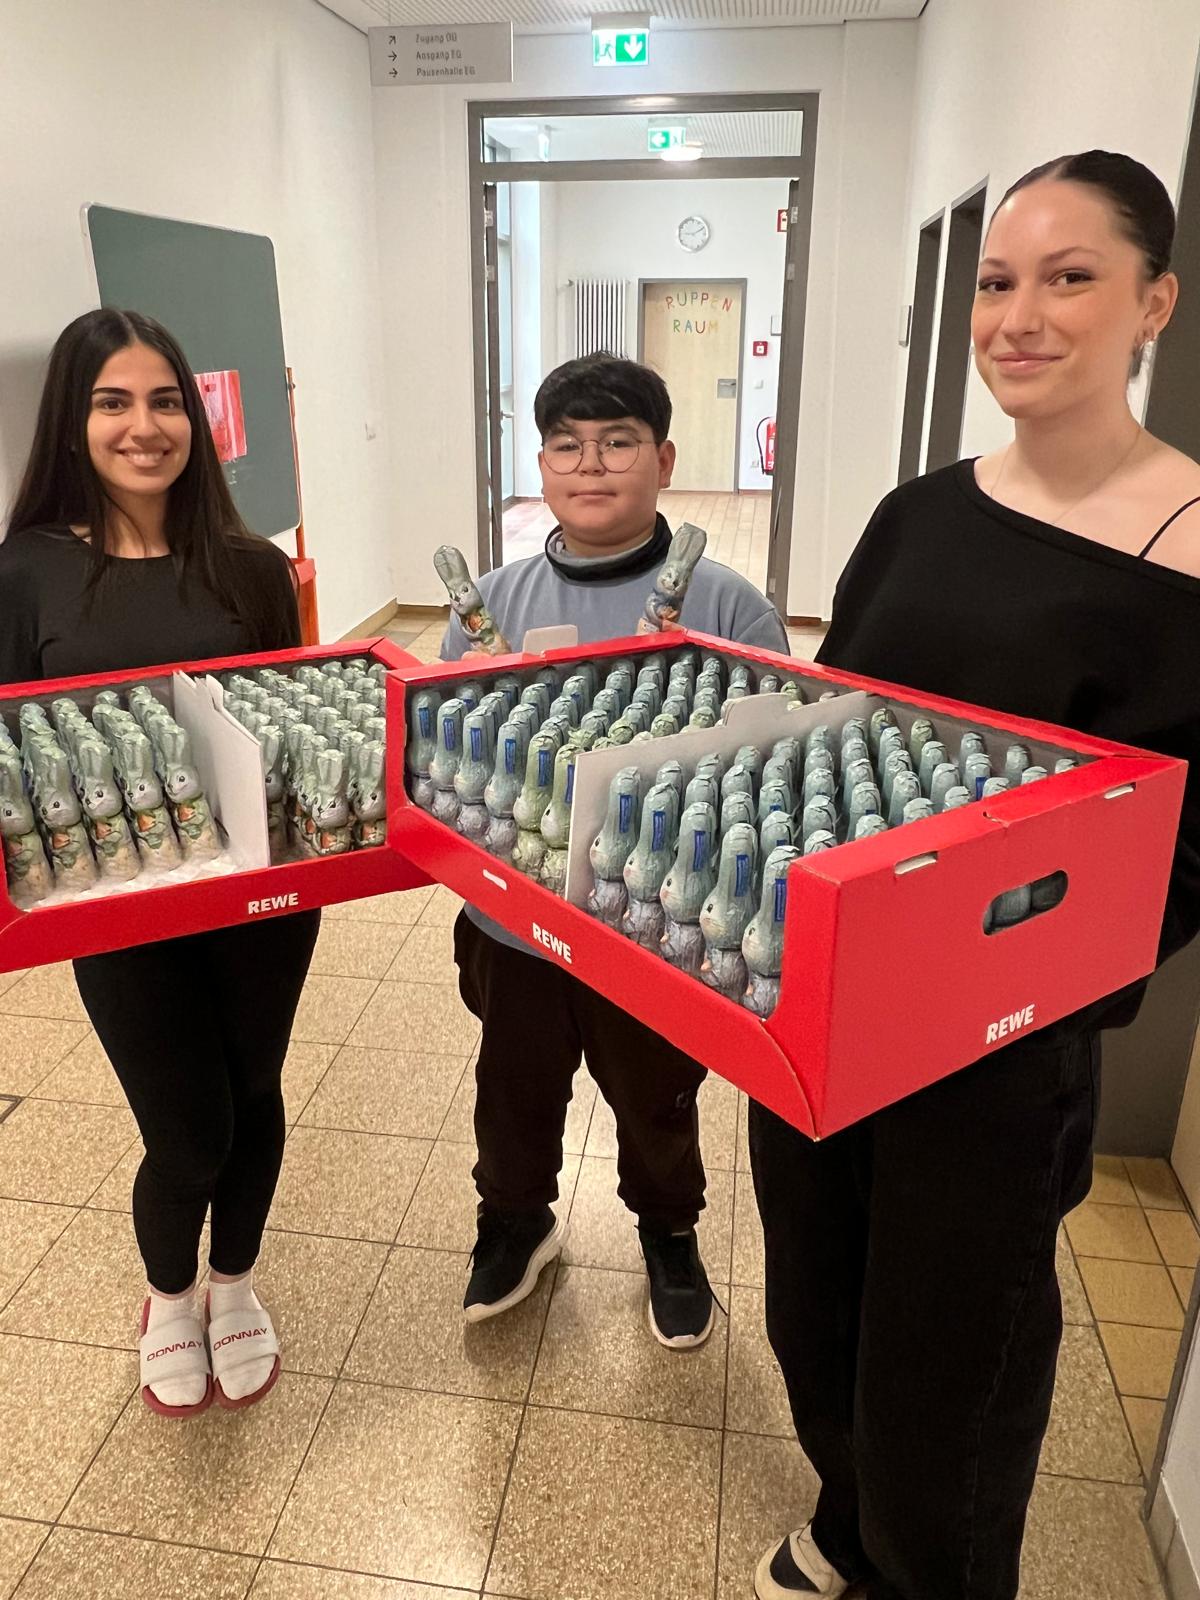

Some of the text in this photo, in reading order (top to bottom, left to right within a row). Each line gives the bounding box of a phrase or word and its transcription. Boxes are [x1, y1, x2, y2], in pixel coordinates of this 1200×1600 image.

[656, 291, 733, 312] RUPPEN
[673, 319, 719, 334] RAUM
[248, 892, 299, 915] REWE
[532, 922, 572, 964] REWE
[986, 1003, 1035, 1044] REWE
[146, 1340, 202, 1361] DONNAY
[212, 1327, 268, 1351] DONNAY
